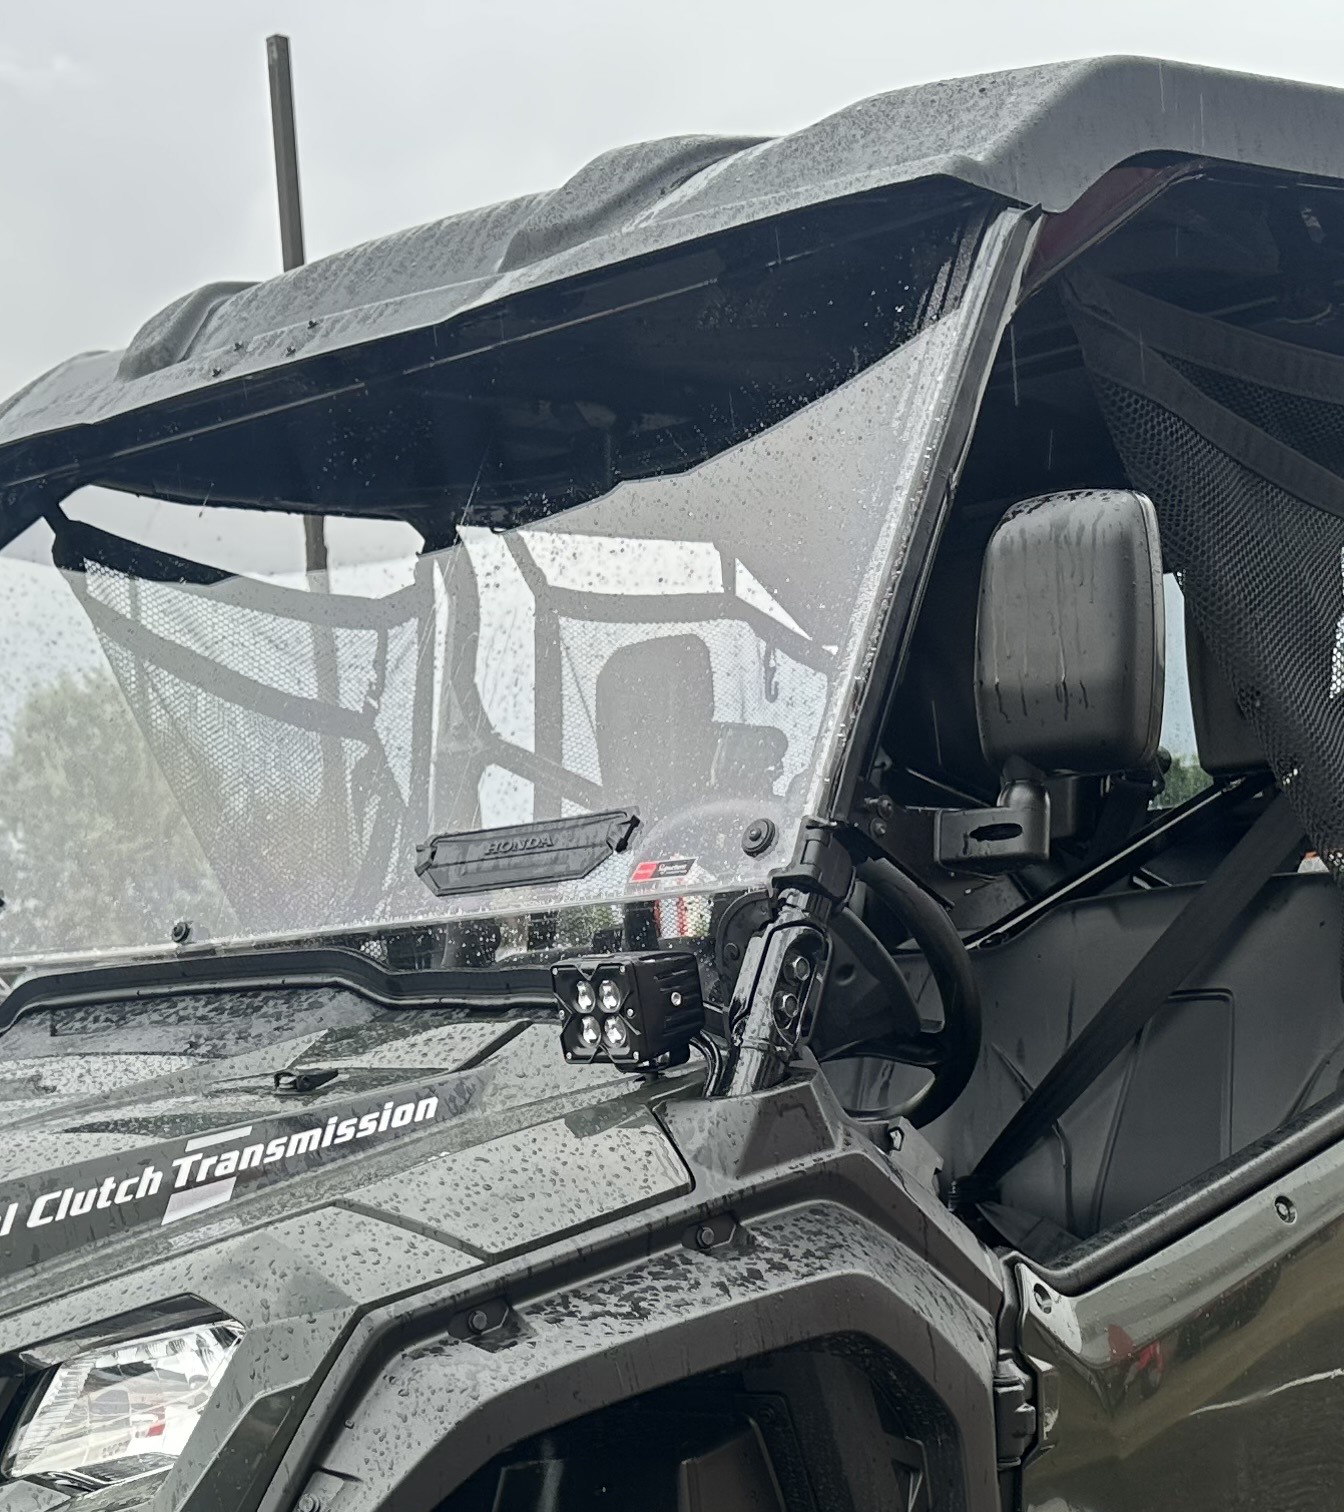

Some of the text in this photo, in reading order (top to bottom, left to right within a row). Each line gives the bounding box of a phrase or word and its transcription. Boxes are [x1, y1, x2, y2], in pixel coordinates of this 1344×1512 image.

[484, 836, 554, 856] HONDA
[26, 1165, 163, 1228] Clutch
[172, 1097, 438, 1188] Transmission
